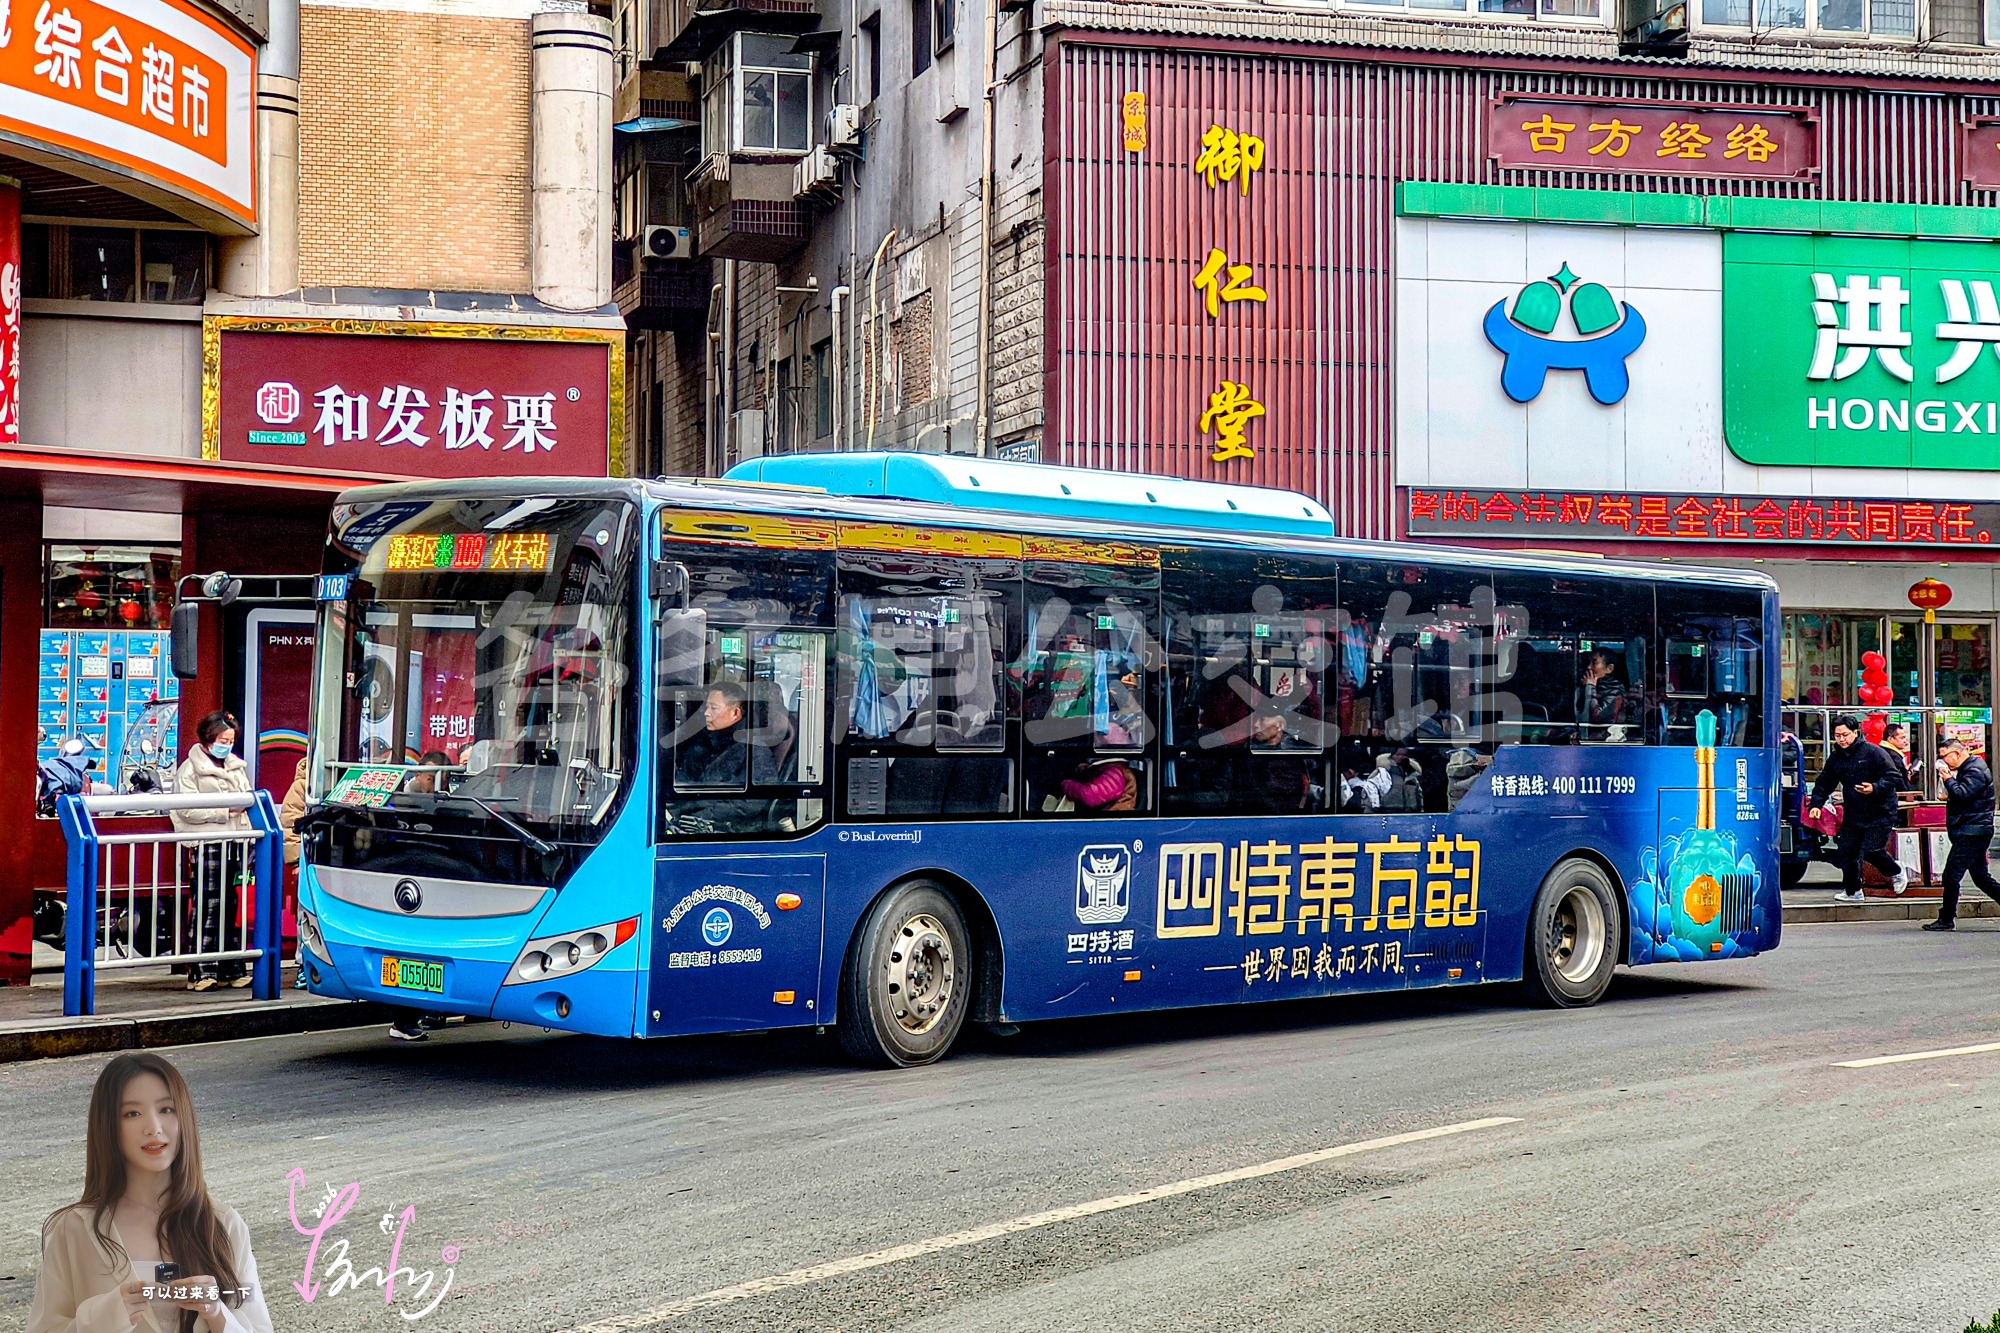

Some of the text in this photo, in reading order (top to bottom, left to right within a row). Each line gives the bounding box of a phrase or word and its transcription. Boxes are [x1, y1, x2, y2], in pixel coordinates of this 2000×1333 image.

[1521, 113, 1779, 163] 古方经络
[1193, 123, 1268, 464] 御仁堂
[313, 384, 558, 453] 和发板栗
[1806, 397, 1997, 435] HONGXI
[249, 431, 306, 445] Since 2002
[1410, 490, 1991, 543] 者的合法权益是全社会的共同责任。
[489, 533, 549, 569] 火车站
[325, 577, 345, 598] 103
[1491, 774, 1636, 797] 特香热线: 400 111 7999
[662, 884, 772, 933] 九江市公共交通集团公司
[1067, 929, 1135, 954] 四特酒
[1240, 940, 1401, 984] 世界因我而不同
